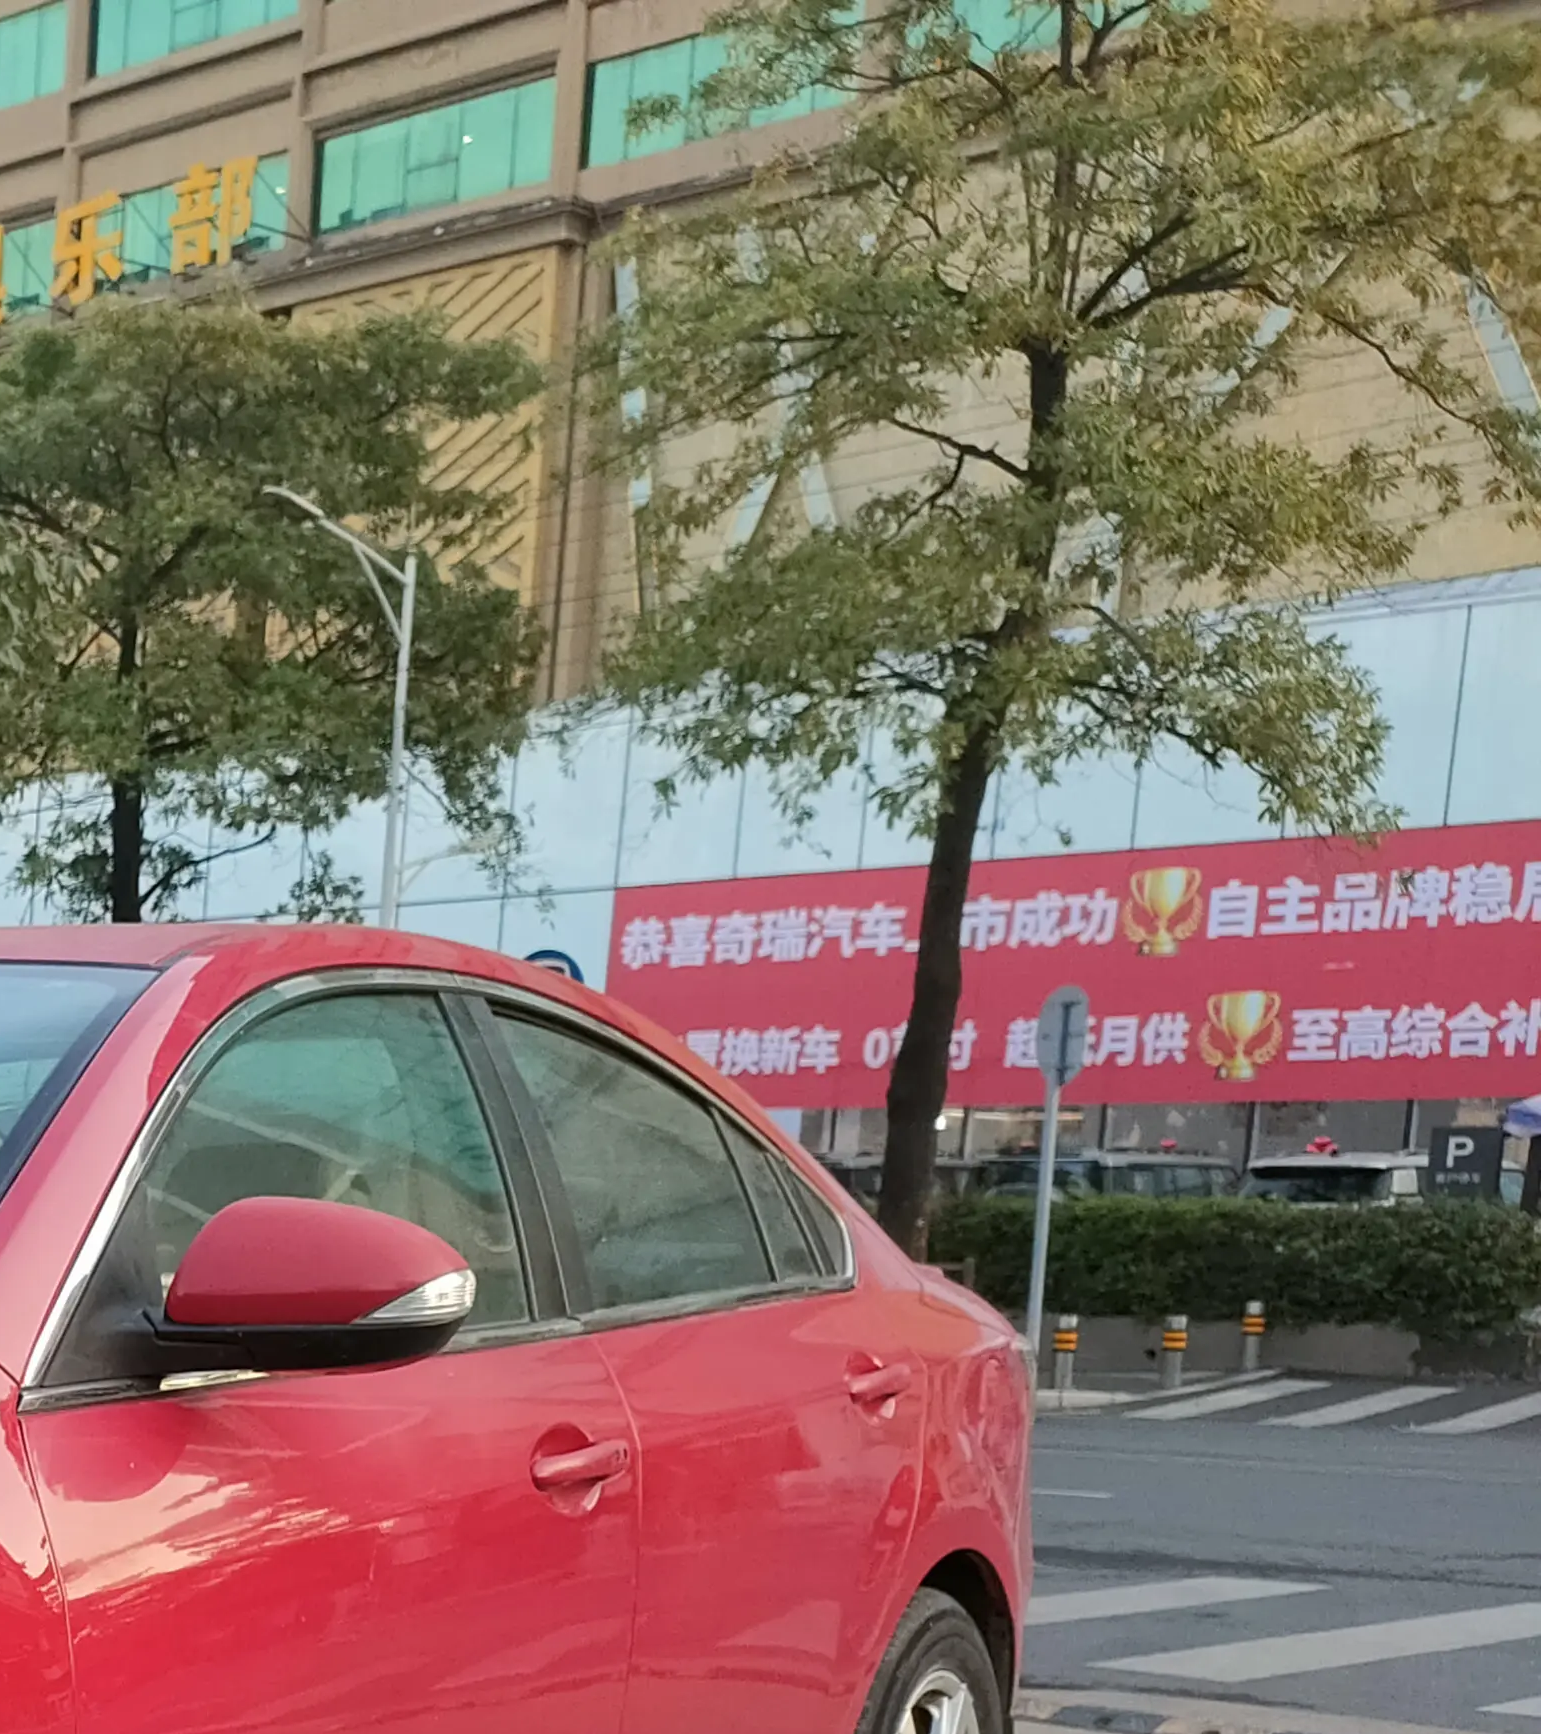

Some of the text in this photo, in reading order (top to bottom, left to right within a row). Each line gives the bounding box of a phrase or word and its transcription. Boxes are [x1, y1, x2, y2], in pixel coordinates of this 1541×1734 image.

[620, 888, 1117, 971] 恭喜奇瑞汽车市成功
[677, 1023, 842, 1076] 置换新车
[862, 1018, 978, 1070] 0付
[1445, 1135, 1475, 1169] P
